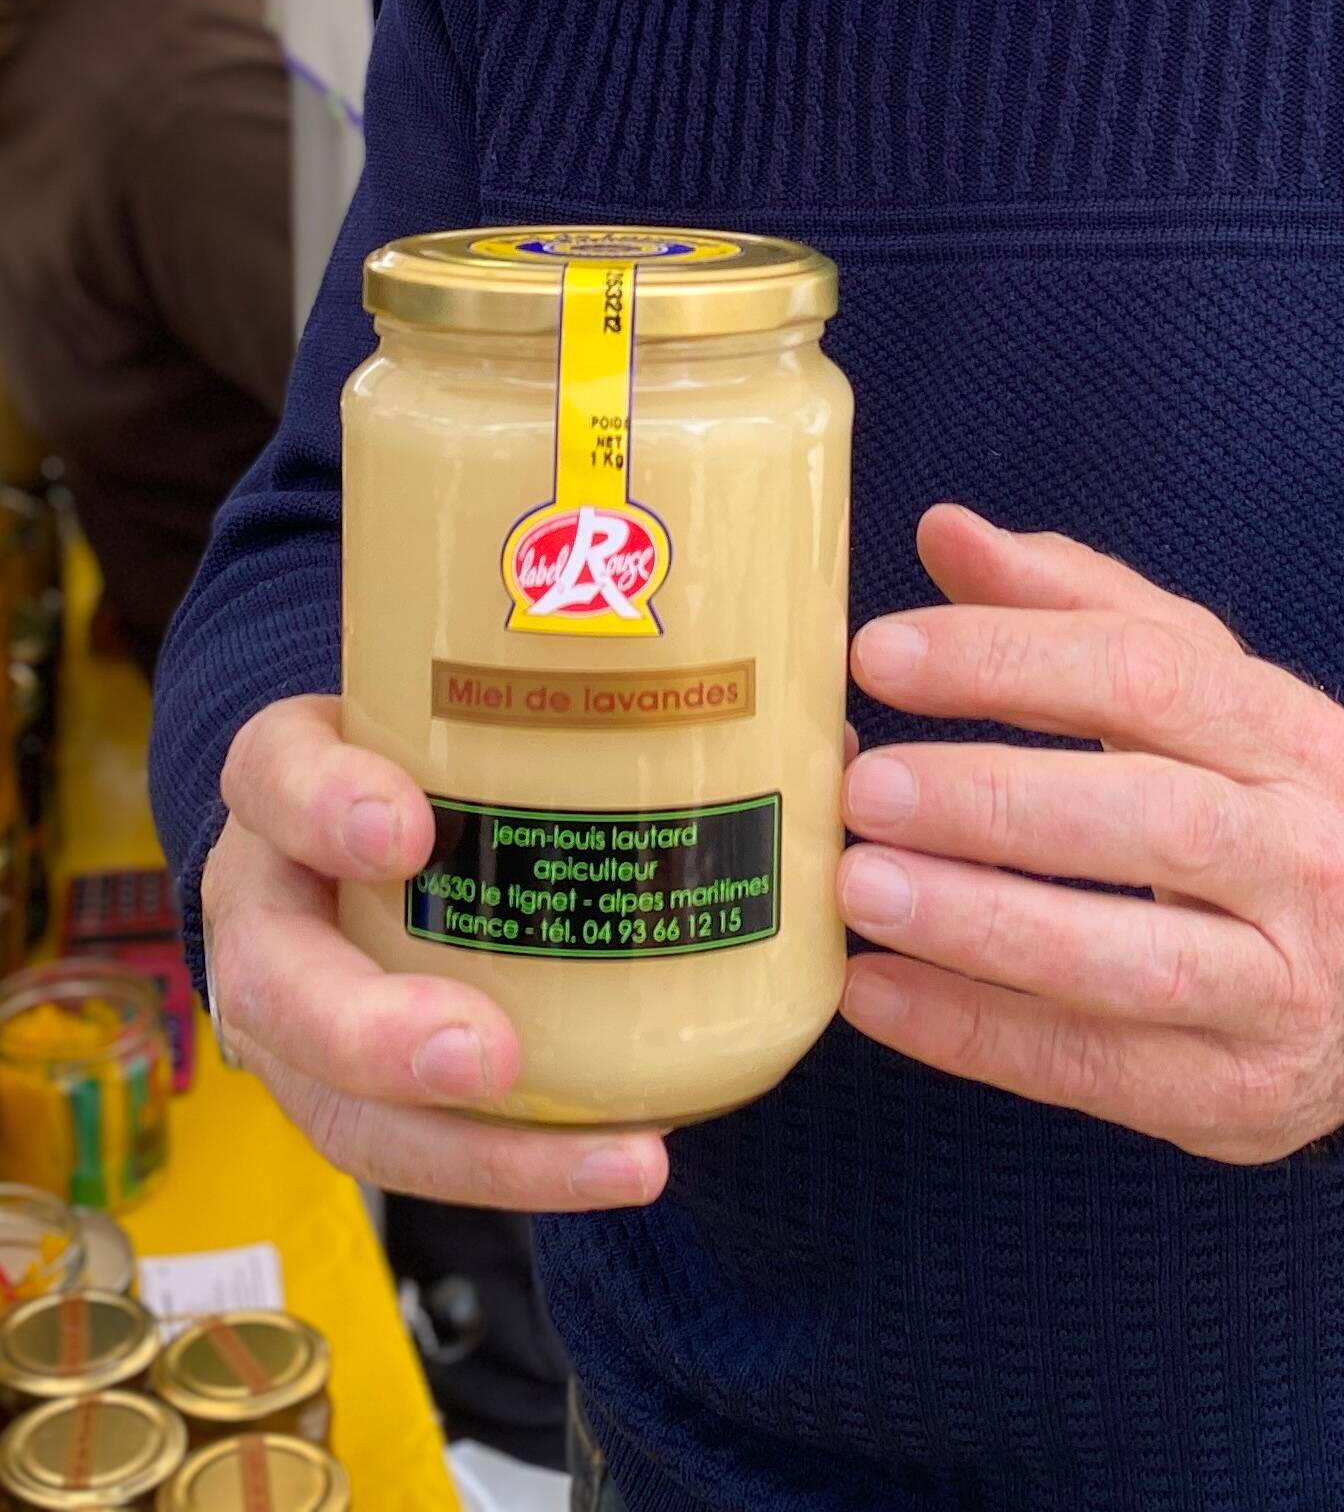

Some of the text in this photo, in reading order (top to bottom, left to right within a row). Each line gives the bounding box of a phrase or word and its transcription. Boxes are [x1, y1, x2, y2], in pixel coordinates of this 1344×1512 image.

[597, 435, 622, 449] NET
[448, 677, 739, 714] Miel de lavandes
[492, 819, 698, 852] jean-louis lautard
[533, 855, 658, 886] apiculteur
[481, 879, 502, 907] le
[507, 883, 577, 915] tignet
[599, 888, 664, 918] alpes
[670, 874, 771, 909] maritimes
[446, 905, 520, 940] france
[541, 916, 577, 944] tél.
[582, 918, 612, 945] 04
[618, 917, 647, 945] 93
[652, 916, 680, 944] 66
[687, 910, 712, 939] 12
[718, 906, 743, 934] 15
